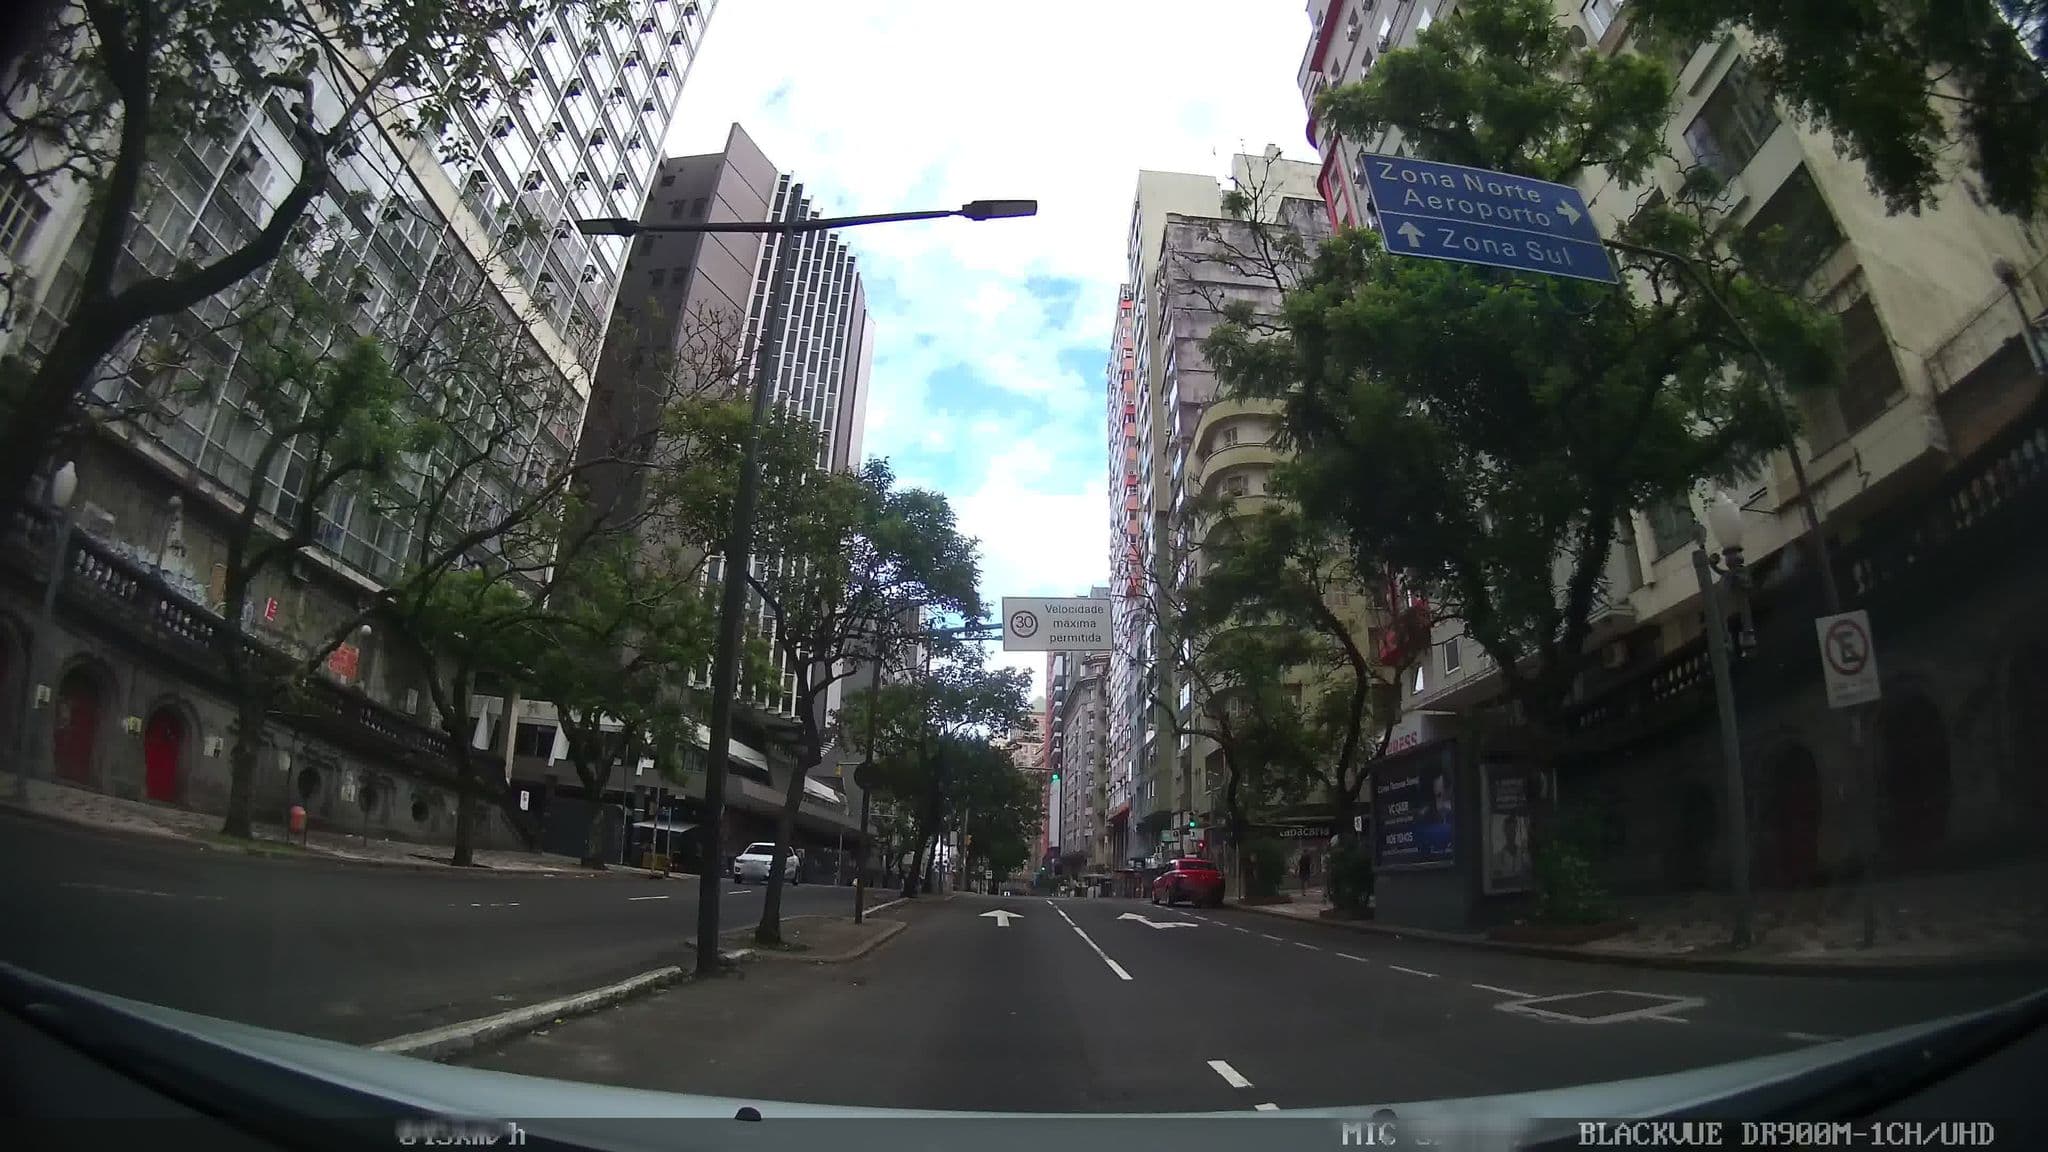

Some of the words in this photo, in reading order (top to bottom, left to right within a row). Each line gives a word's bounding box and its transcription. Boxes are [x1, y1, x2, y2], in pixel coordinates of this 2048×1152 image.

[1376, 162, 1456, 189] Zona
[1463, 173, 1542, 204] Norte
[1404, 188, 1550, 227] Aeroporto
[1437, 228, 1517, 257] Zona
[1526, 242, 1573, 267] Sul
[1015, 615, 1034, 628] 30
[1045, 604, 1104, 614] Velocidade
[1049, 633, 1102, 644] permitida
